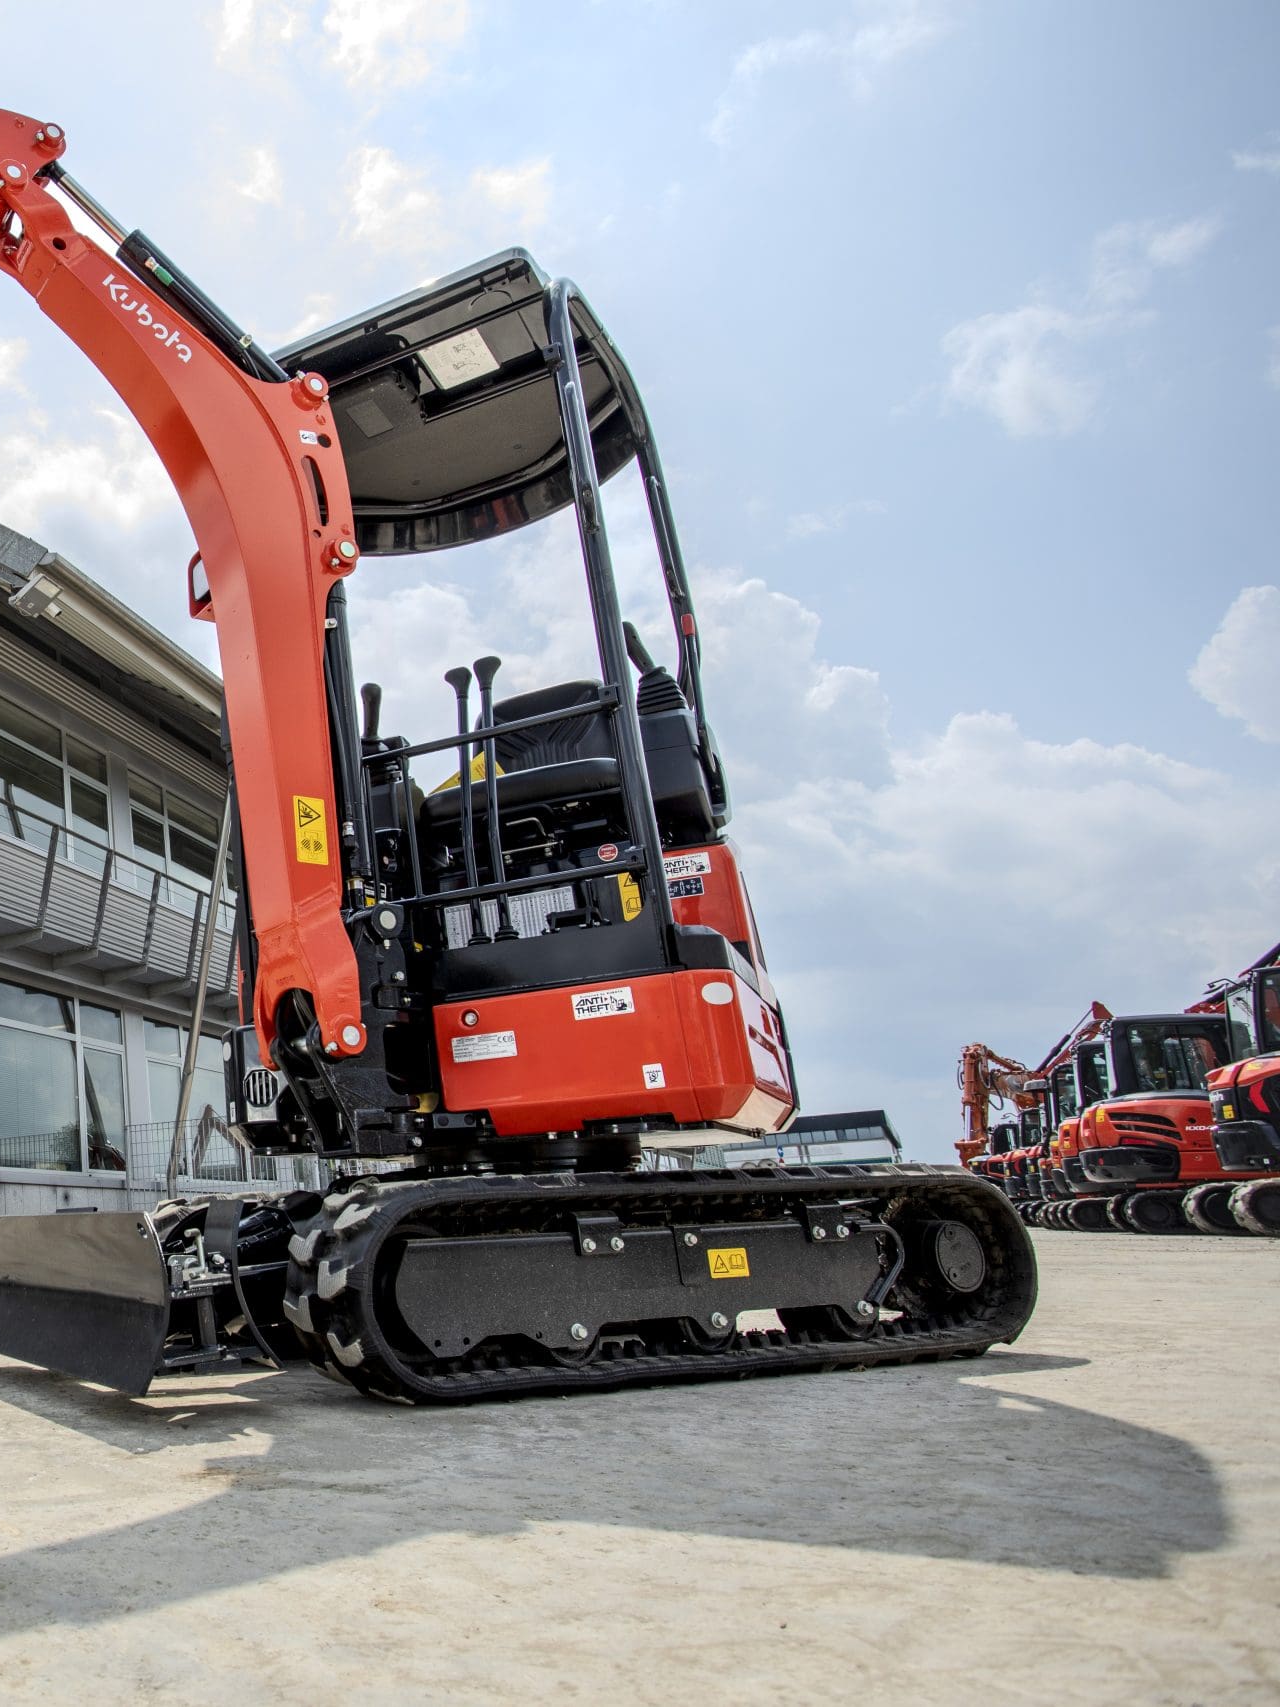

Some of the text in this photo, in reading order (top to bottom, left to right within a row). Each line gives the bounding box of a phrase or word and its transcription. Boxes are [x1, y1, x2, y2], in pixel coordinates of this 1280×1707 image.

[102, 274, 192, 363] Kubota
[664, 866, 690, 874] HEFT
[575, 1003, 609, 1014] THEFT
